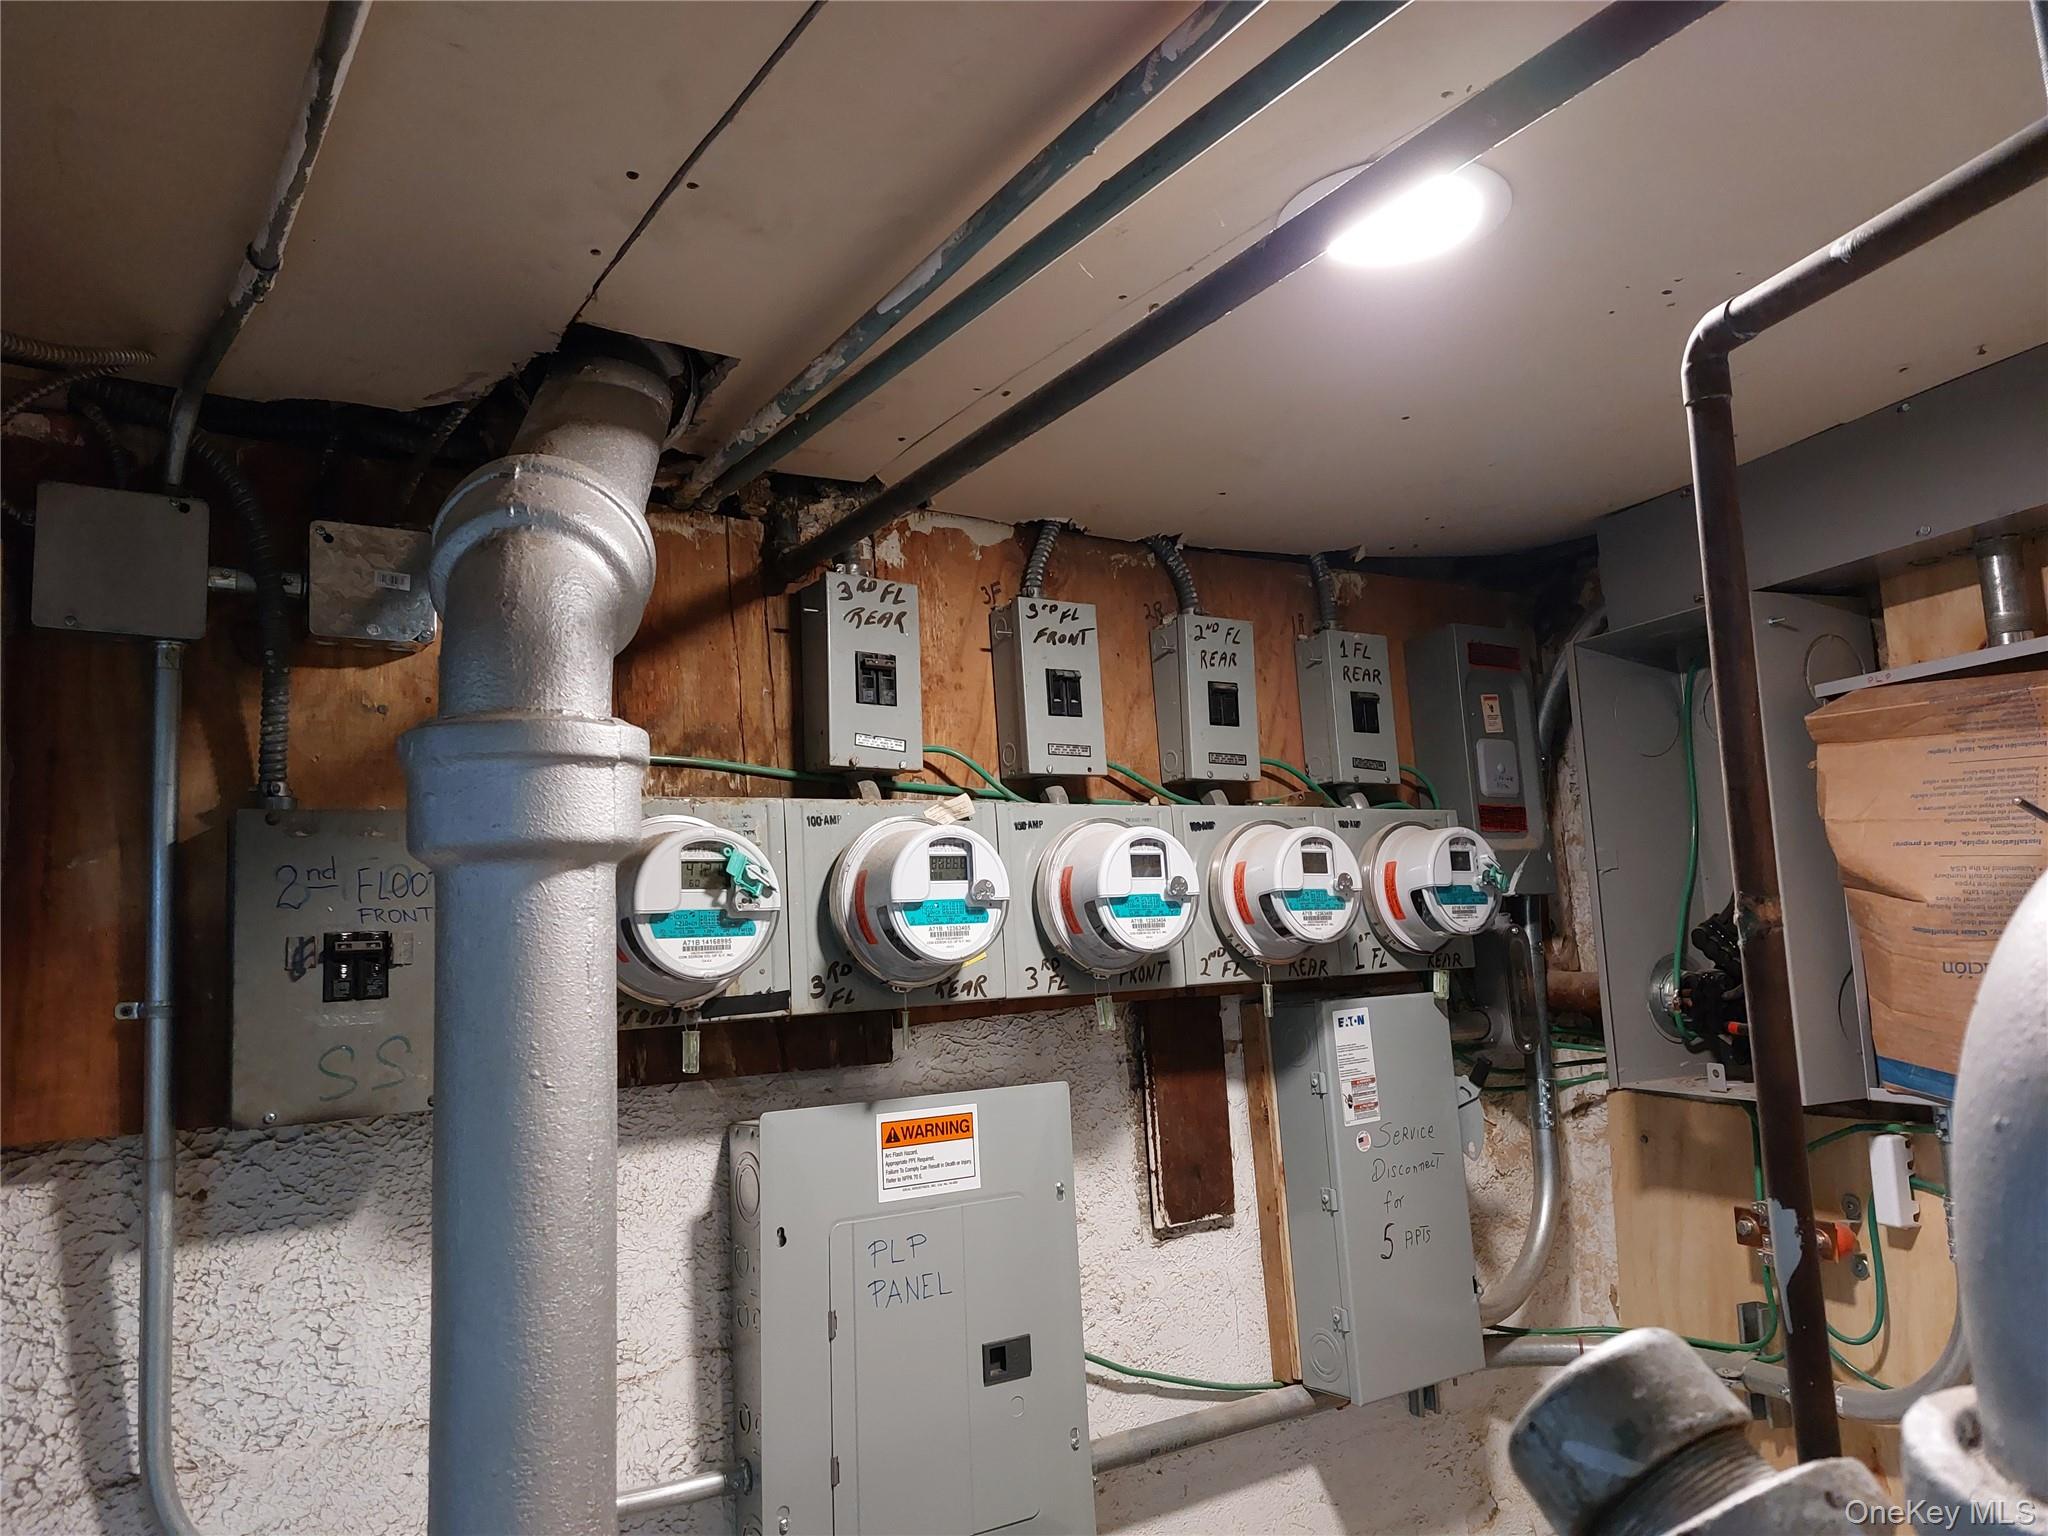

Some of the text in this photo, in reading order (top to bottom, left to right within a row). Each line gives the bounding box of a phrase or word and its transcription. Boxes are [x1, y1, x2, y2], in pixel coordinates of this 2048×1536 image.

[880, 583, 906, 605] FL
[844, 607, 908, 633] REAR
[1060, 608, 1079, 624] FL
[1033, 627, 1095, 645] FRONT
[1225, 627, 1240, 645] FL
[1201, 650, 1237, 669] REAR
[1340, 640, 1371, 659] 1 FL
[1343, 666, 1382, 685] REAR
[356, 906, 433, 924] FRONT
[1372, 948, 1388, 969] FL
[1221, 960, 1244, 978] FL
[1048, 974, 1070, 993] FL
[828, 986, 856, 1008] FL
[900, 1118, 970, 1140] WARNING
[1384, 1190, 1404, 1215] for
[867, 1233, 928, 1268] PLP
[1380, 1222, 1395, 1260] 5
[867, 1272, 953, 1309] PANEL
